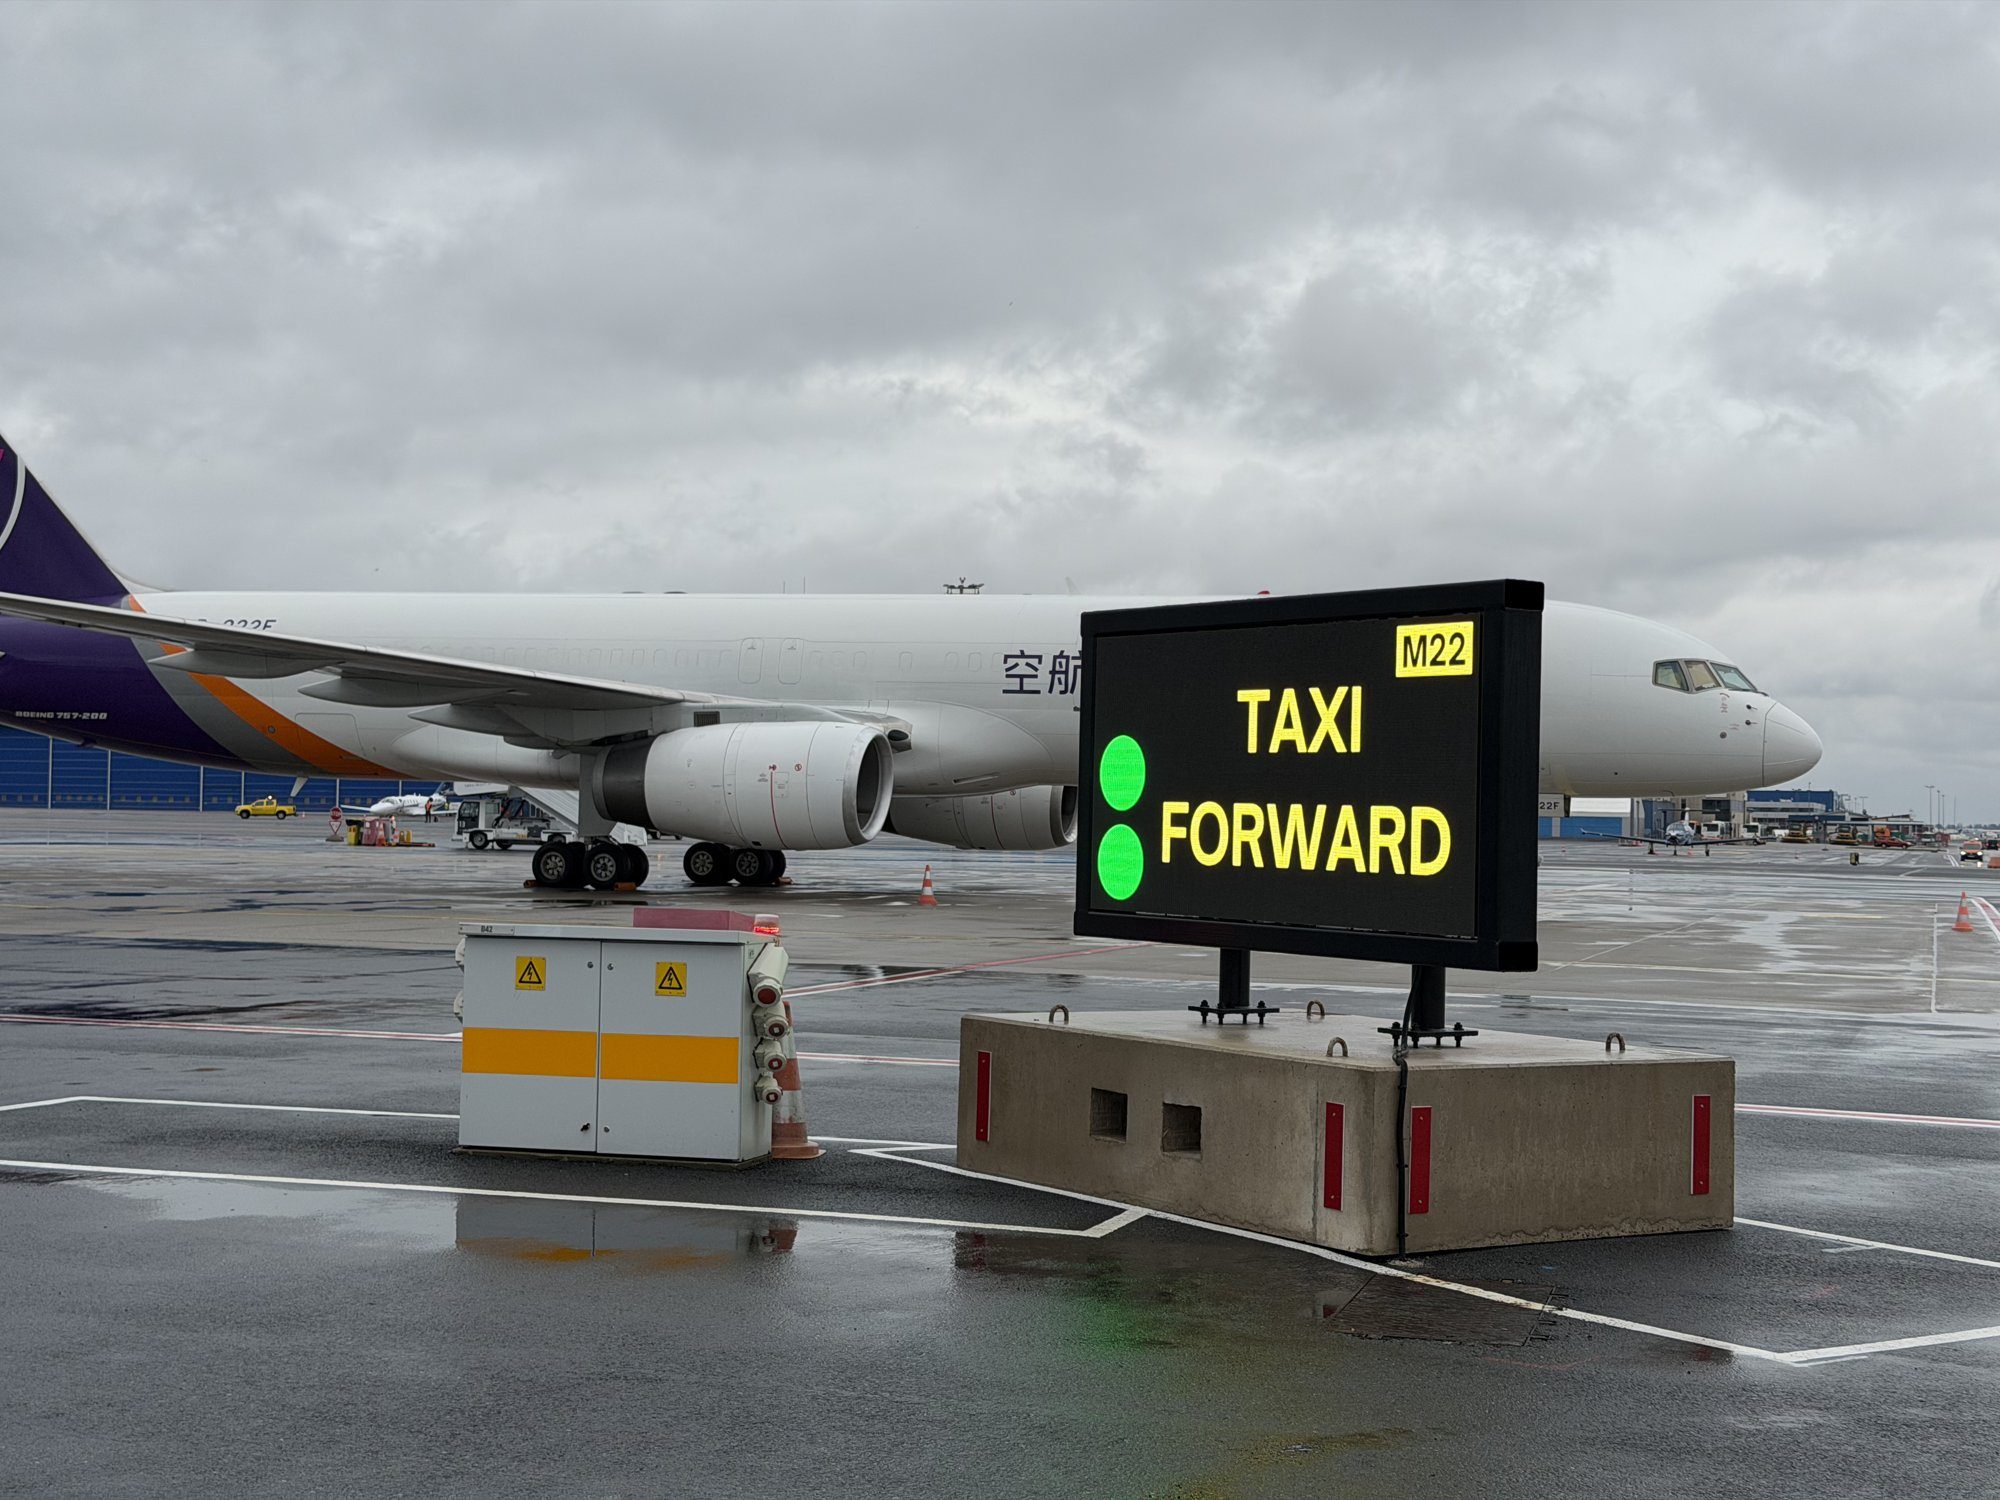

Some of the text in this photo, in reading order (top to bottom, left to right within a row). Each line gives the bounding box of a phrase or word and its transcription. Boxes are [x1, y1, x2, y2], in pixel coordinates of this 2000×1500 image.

[1403, 632, 1466, 668] M22
[1002, 649, 1081, 695] 空航
[15, 711, 108, 720] BOEING 757-200
[1237, 685, 1363, 753] TAXI
[1539, 801, 1560, 810] 22F
[1161, 801, 1452, 877] FORWARD
